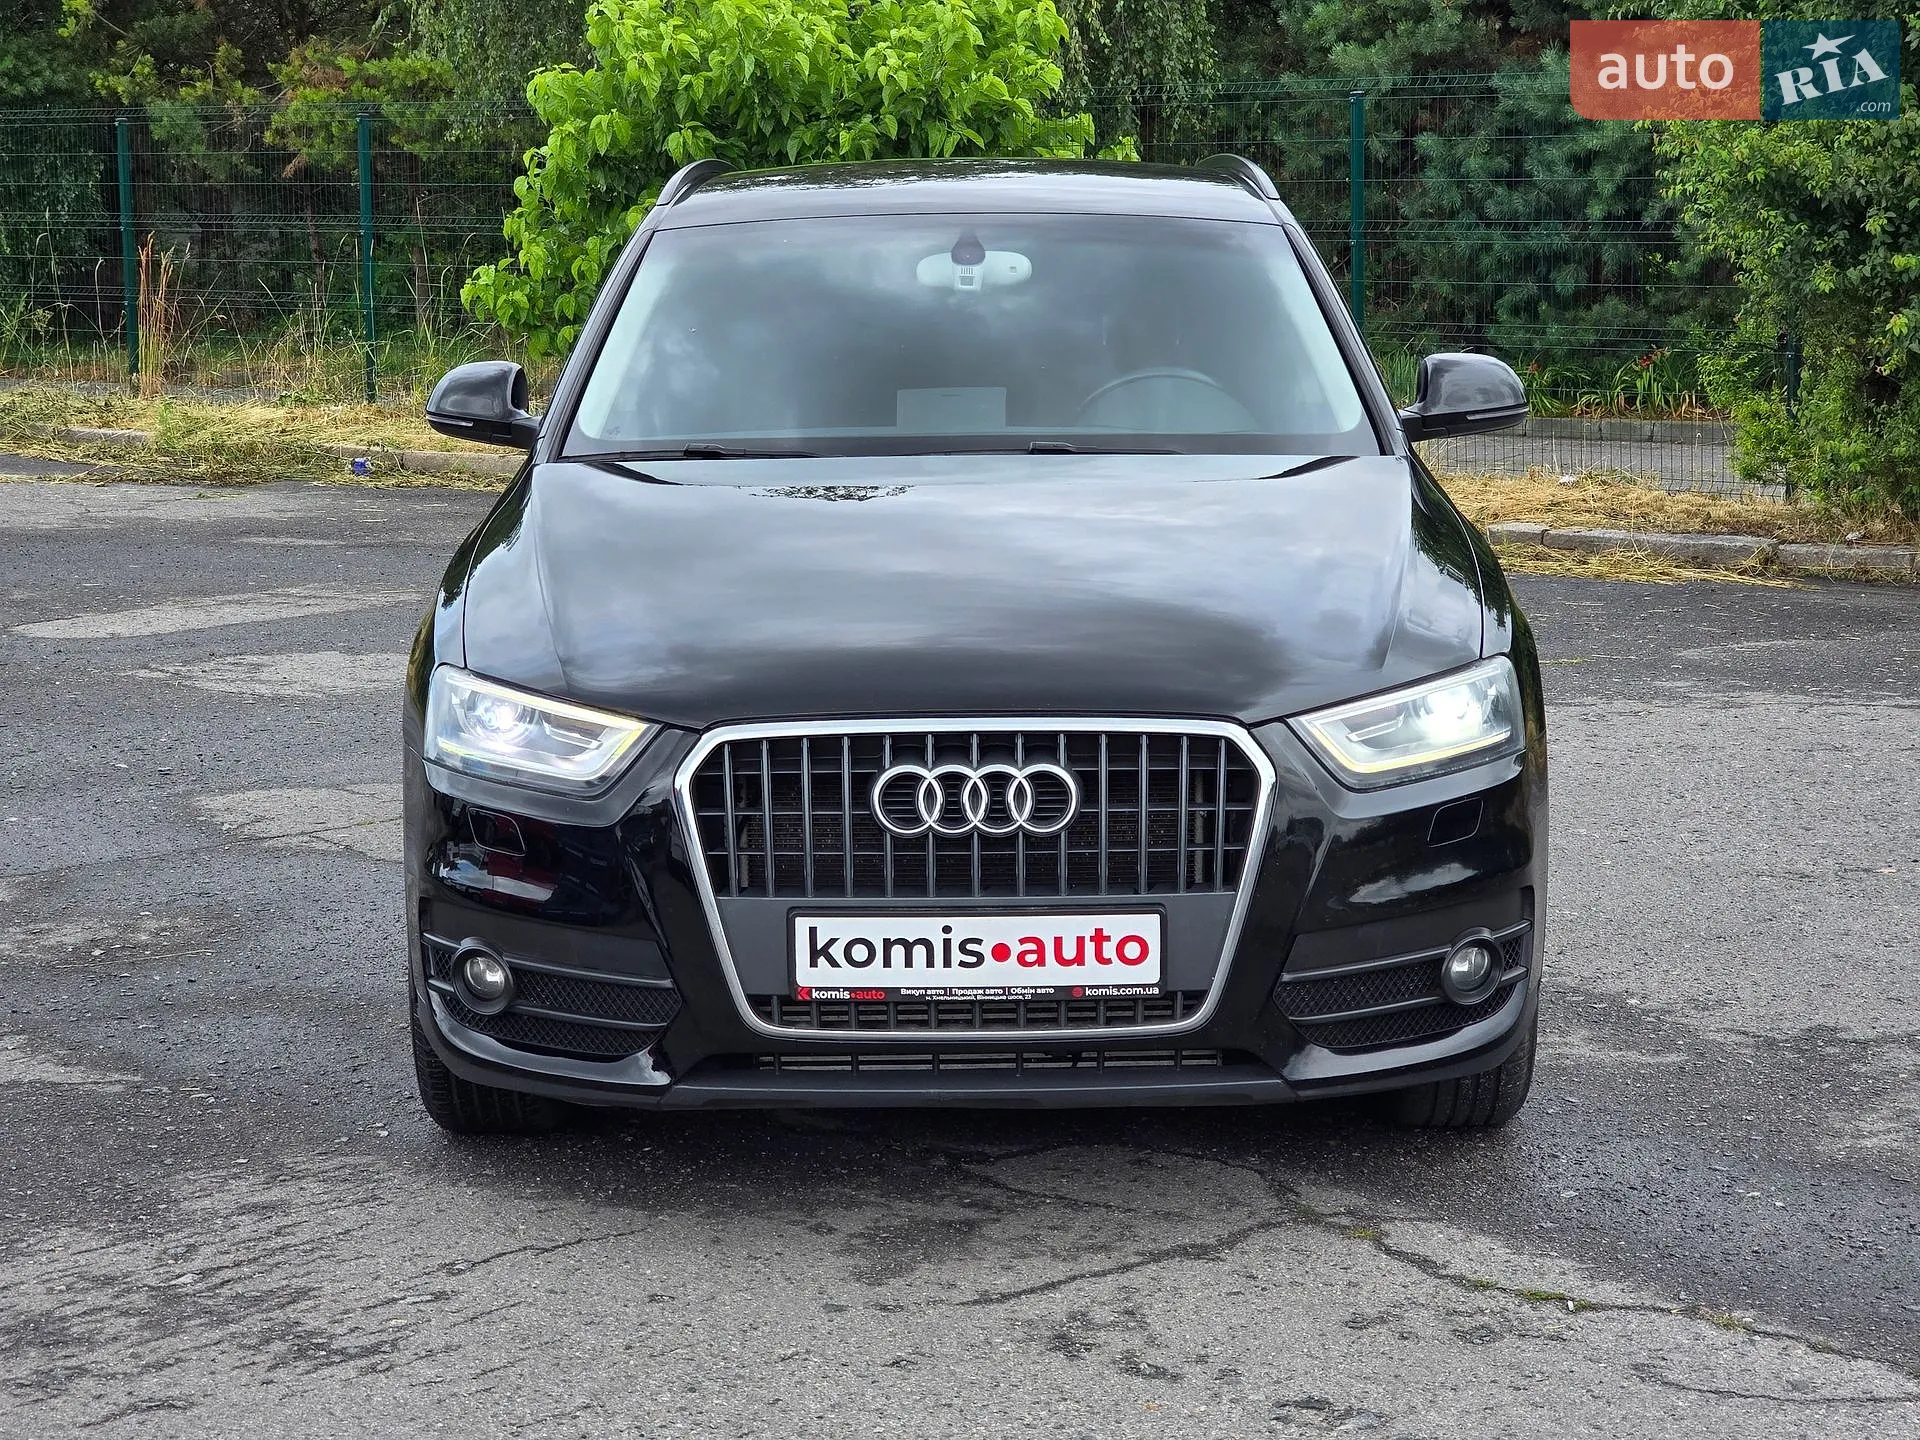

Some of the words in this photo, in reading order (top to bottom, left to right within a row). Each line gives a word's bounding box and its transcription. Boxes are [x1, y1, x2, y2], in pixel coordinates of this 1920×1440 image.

[900, 988, 925, 996] Викуп
[952, 988, 984, 996] Продаж
[1085, 985, 1159, 996] komis.com.ua
